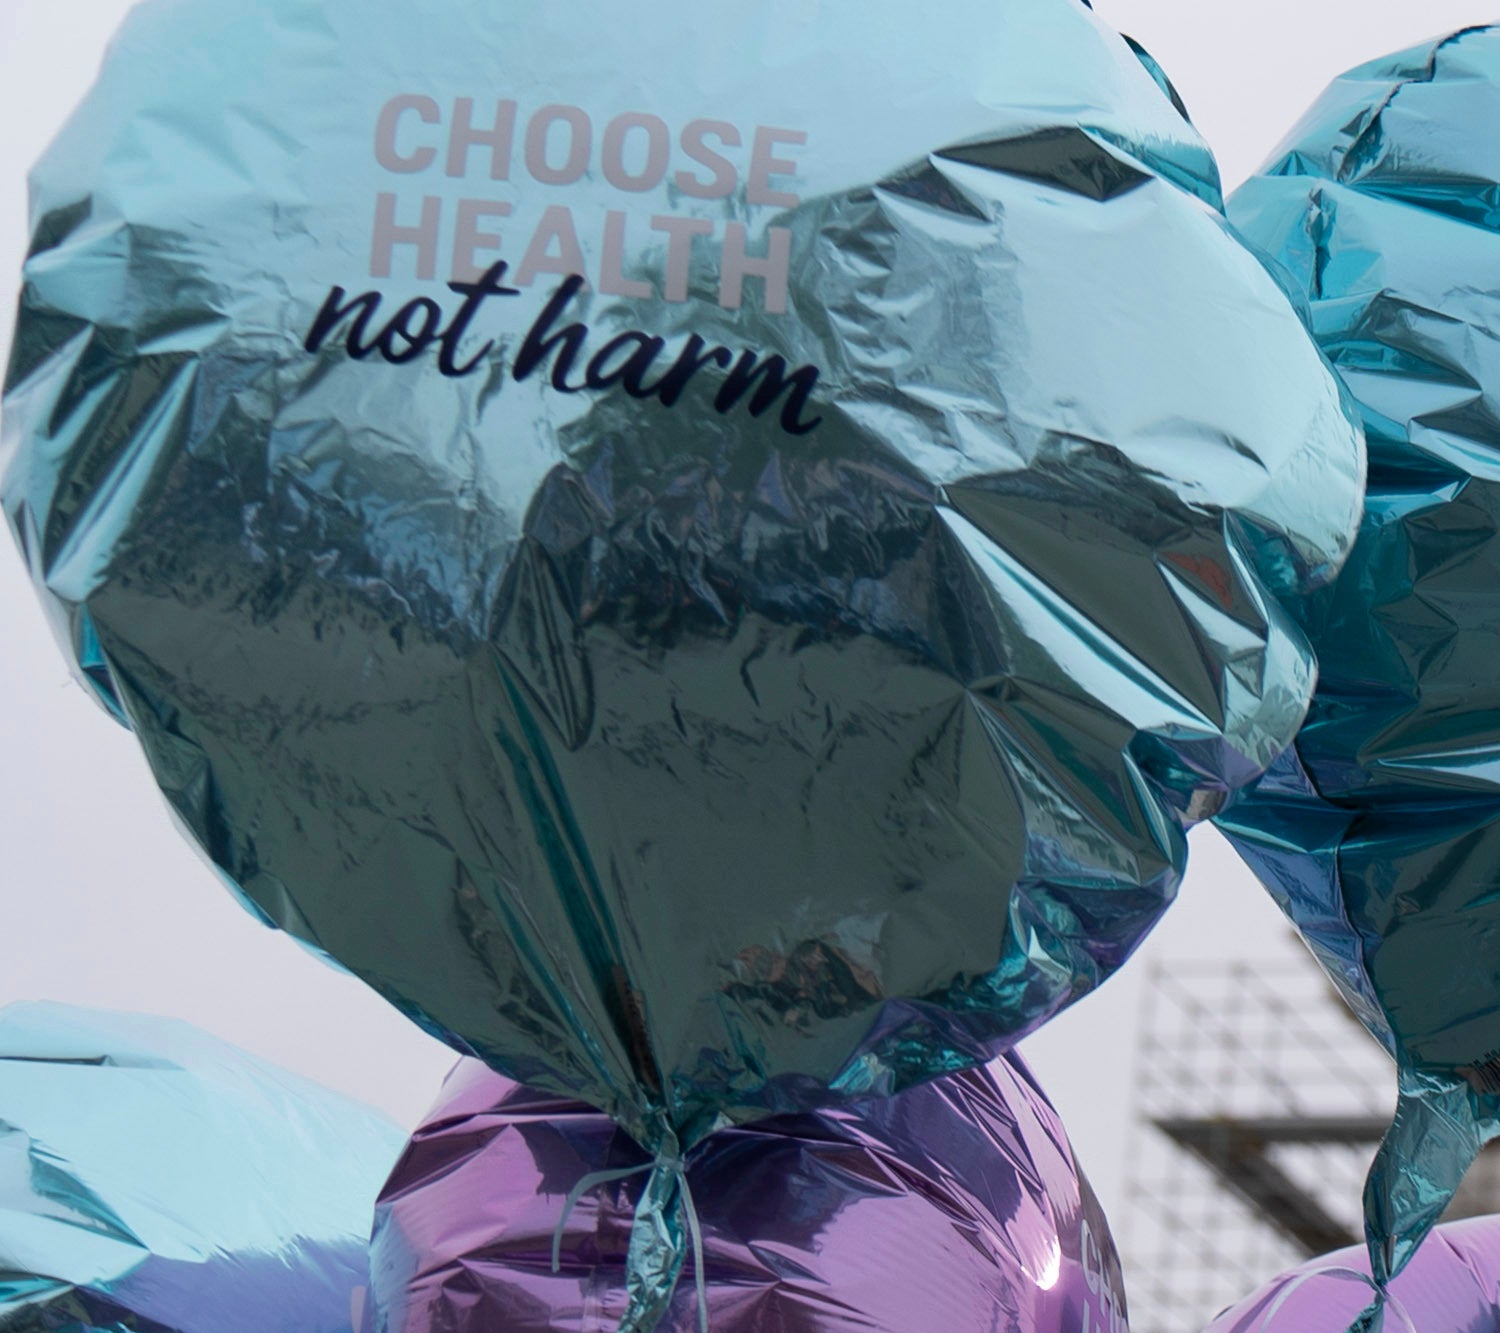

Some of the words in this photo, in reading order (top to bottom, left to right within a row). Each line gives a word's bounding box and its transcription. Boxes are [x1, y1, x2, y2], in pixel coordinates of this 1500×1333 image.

[373, 93, 808, 209] CHOOSE
[369, 193, 791, 314] HEALTH
[304, 260, 520, 377] not
[512, 274, 822, 435] harm
